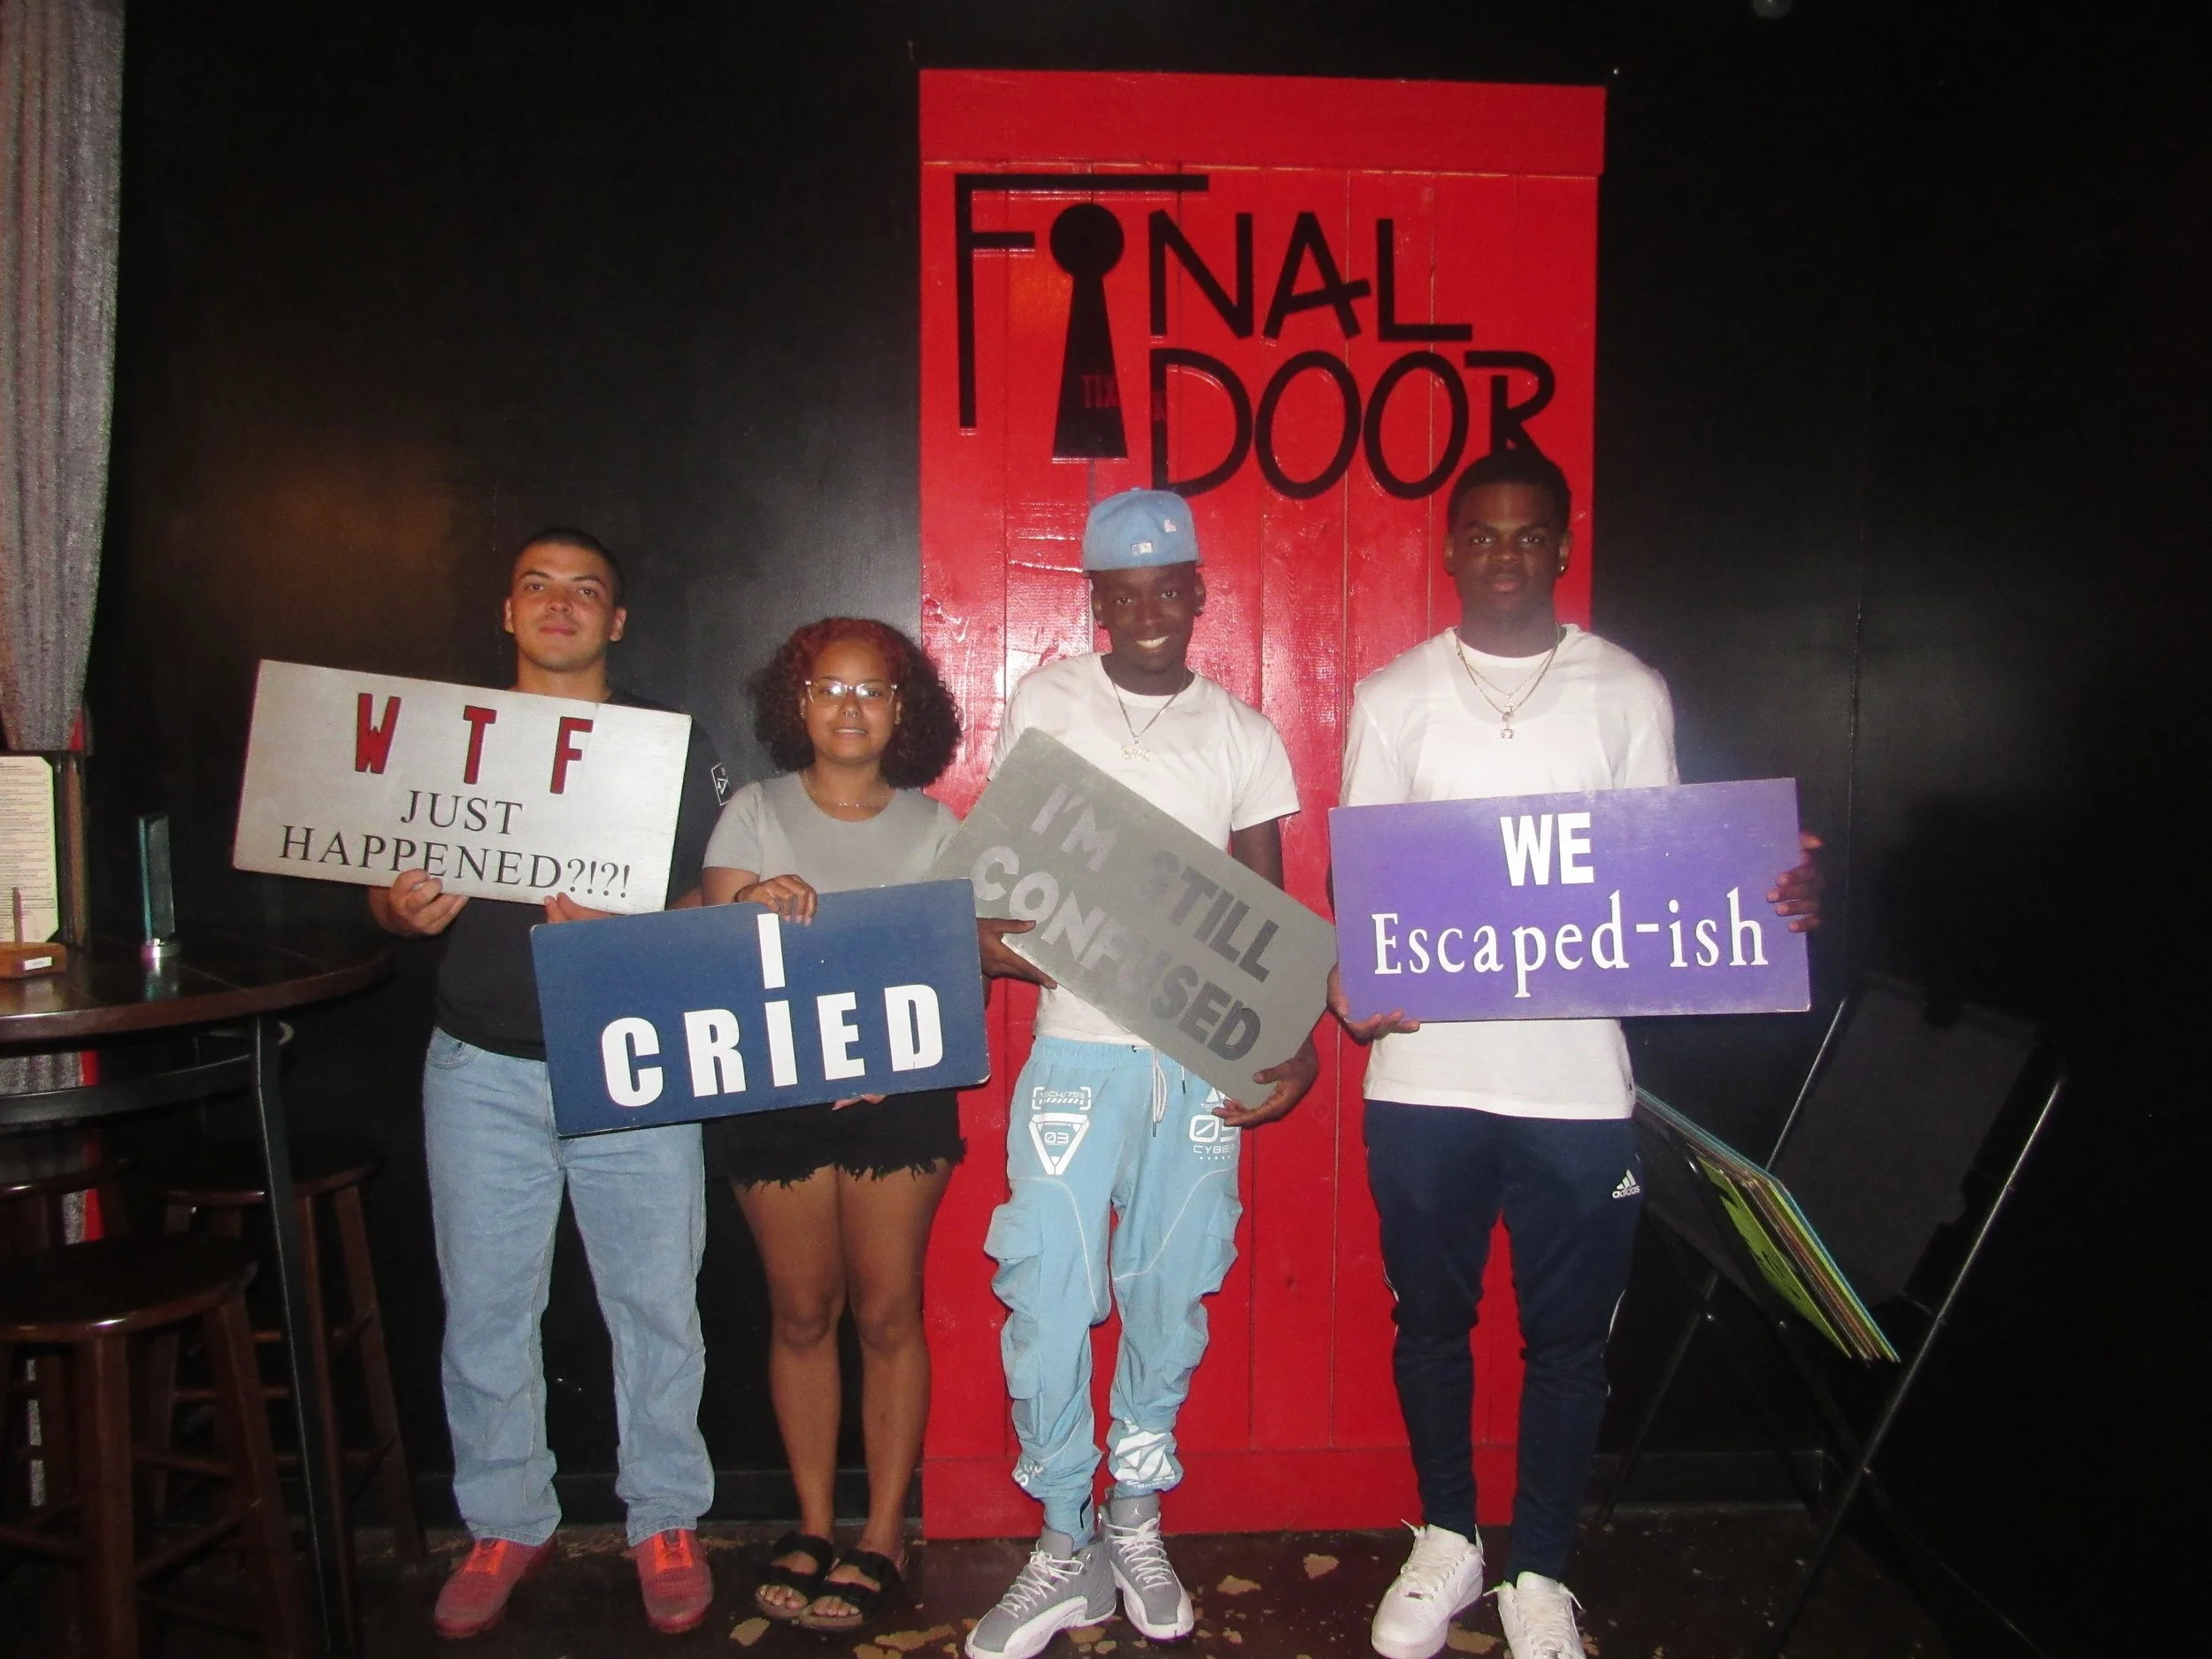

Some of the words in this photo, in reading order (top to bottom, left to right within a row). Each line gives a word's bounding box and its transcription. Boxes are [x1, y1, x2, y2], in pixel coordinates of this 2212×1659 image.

[955, 173, 1472, 458] FINAL
[1151, 349, 1555, 500] DOOR
[400, 790, 523, 835] JUST
[1500, 811, 1594, 887] WE
[279, 824, 630, 898] HAPPENED?!?!
[1030, 780, 1118, 873] I'M
[1147, 850, 1279, 984] STILL
[757, 912, 787, 989] I
[972, 845, 1262, 1061] CONFUSED
[1371, 886, 1769, 998] Escaped-ish
[1045, 1132, 1070, 1145] 03
[1612, 1185, 1640, 1199] adidas
